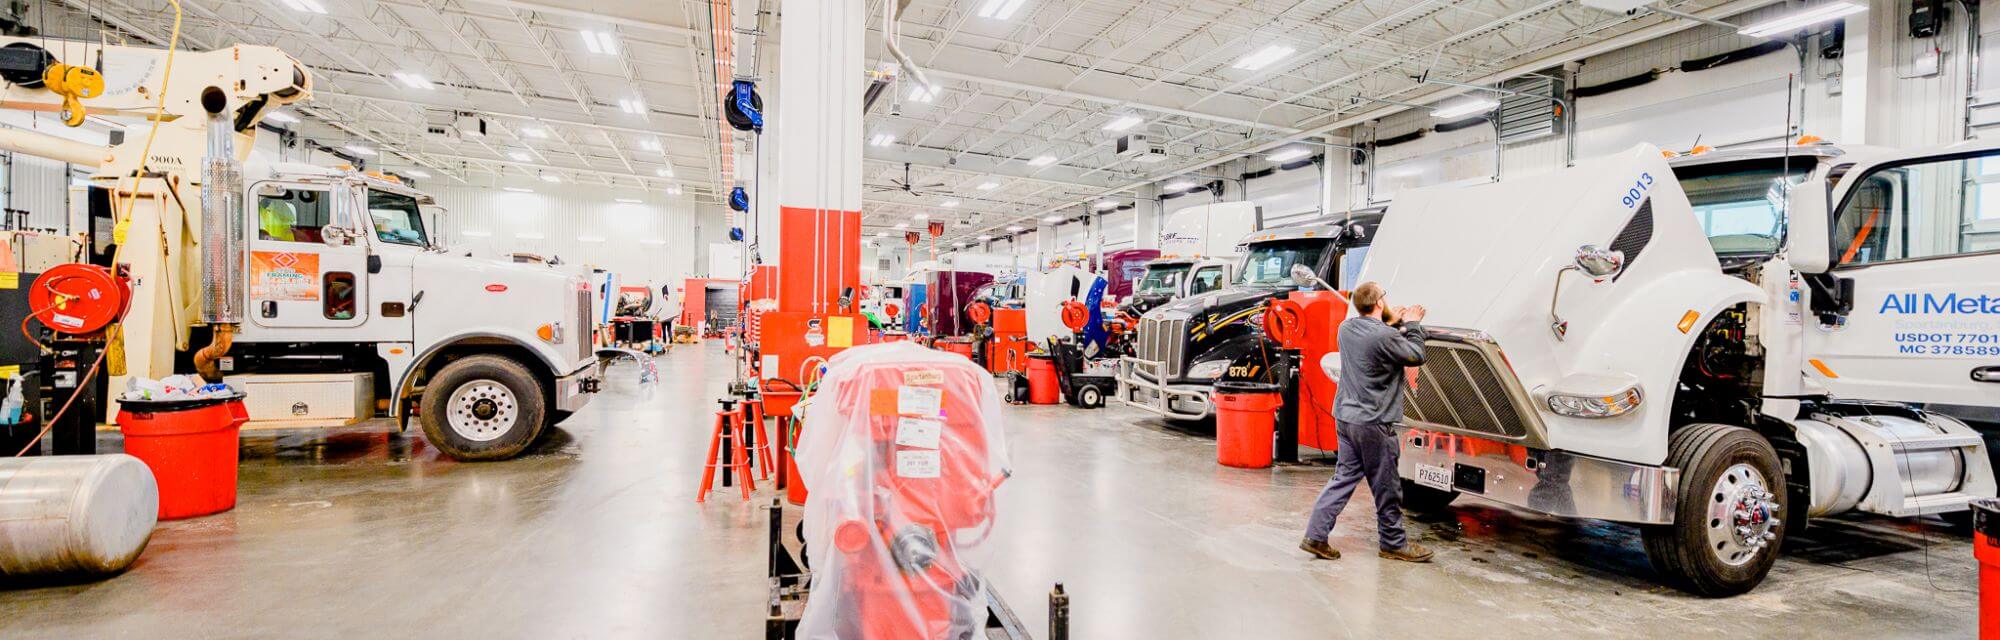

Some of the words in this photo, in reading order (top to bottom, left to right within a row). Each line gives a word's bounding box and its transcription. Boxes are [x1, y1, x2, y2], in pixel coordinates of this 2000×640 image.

[1622, 172, 1653, 208] 9013
[1879, 293, 1917, 314] All
[1924, 292, 2000, 314] Meta
[1895, 333, 1953, 343] USDOT
[1957, 334, 1998, 343] 7701
[1900, 345, 1926, 354] MC
[1931, 345, 2000, 356] 378589
[1229, 366, 1248, 378] 878
